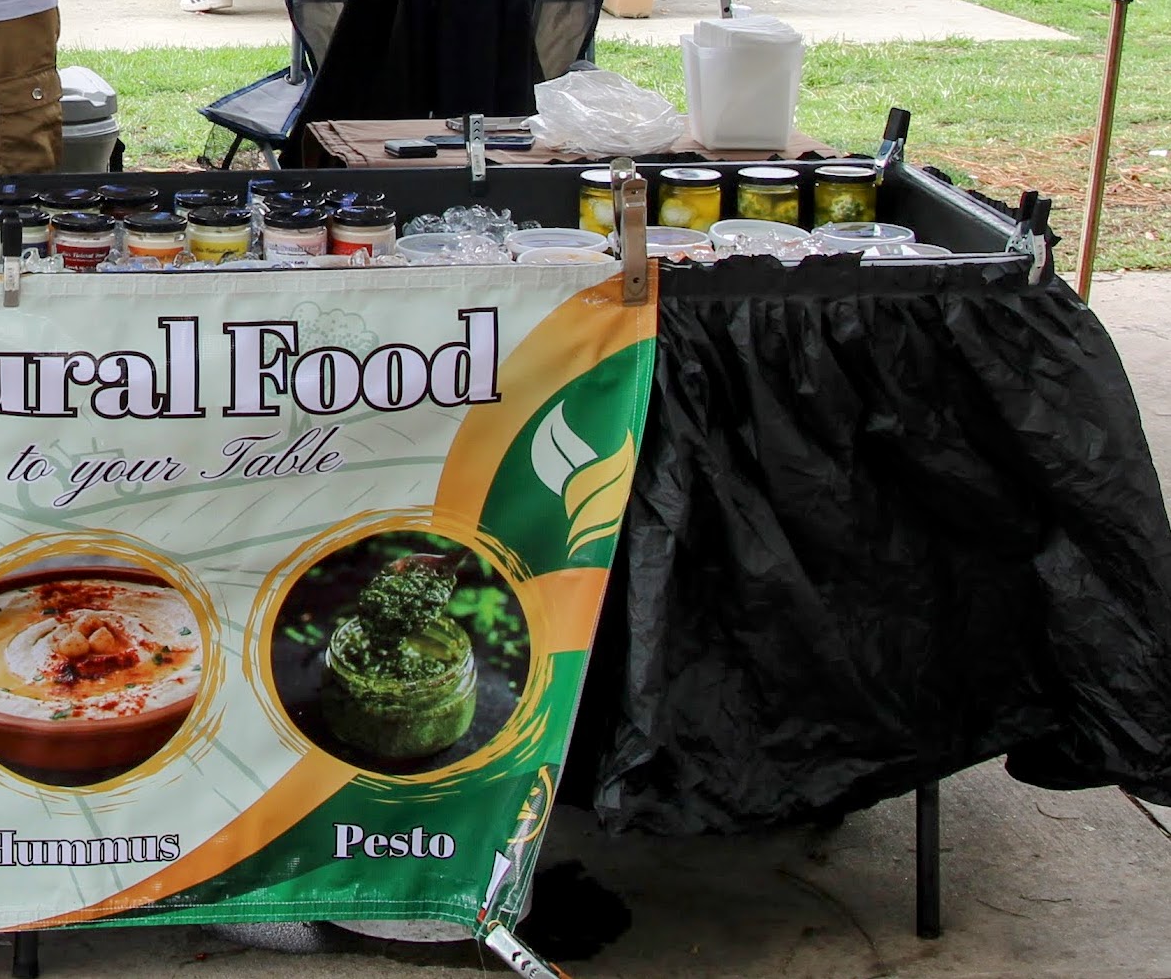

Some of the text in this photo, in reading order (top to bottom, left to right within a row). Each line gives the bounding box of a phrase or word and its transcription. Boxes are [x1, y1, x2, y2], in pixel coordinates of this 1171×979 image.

[222, 307, 502, 418] Food
[5, 440, 57, 484] to
[51, 450, 184, 509] your
[198, 425, 347, 481] Table
[332, 823, 456, 861] Pesto
